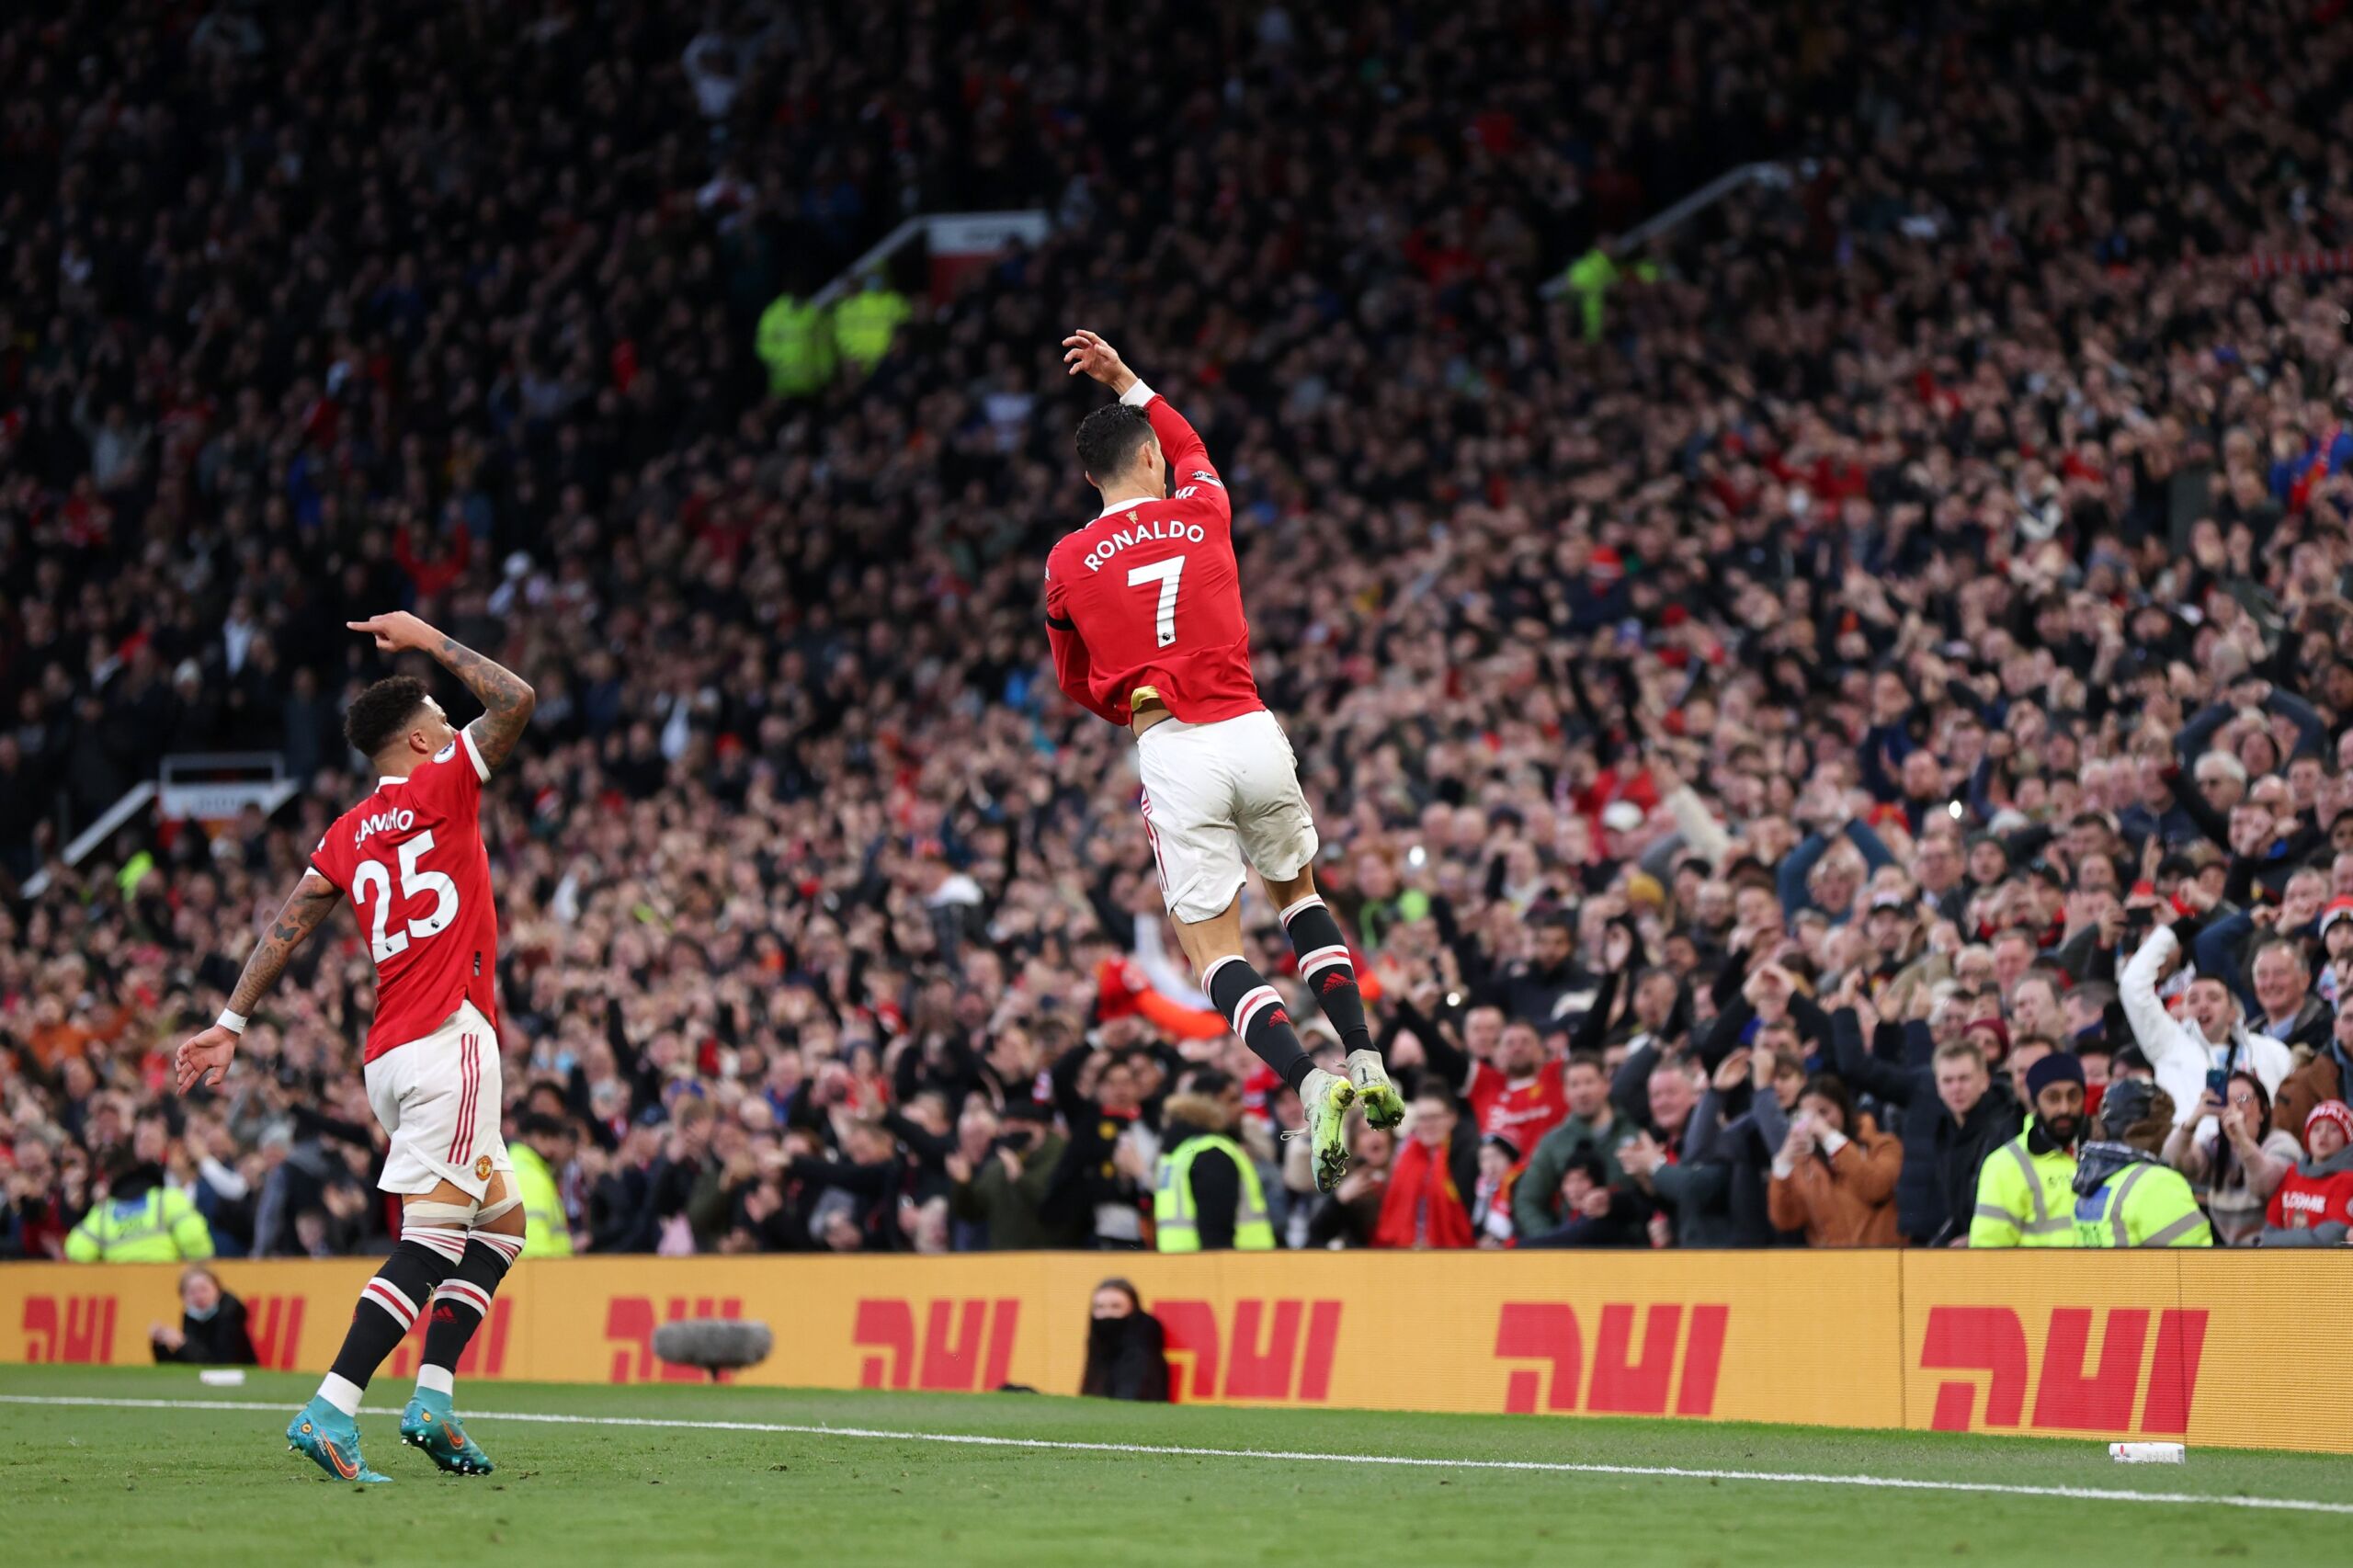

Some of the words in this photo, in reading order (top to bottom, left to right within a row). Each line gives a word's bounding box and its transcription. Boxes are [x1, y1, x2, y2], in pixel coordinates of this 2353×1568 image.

[1084, 520, 1204, 572] RONALDO
[1127, 555, 1186, 648] 7
[352, 829, 460, 964] 25
